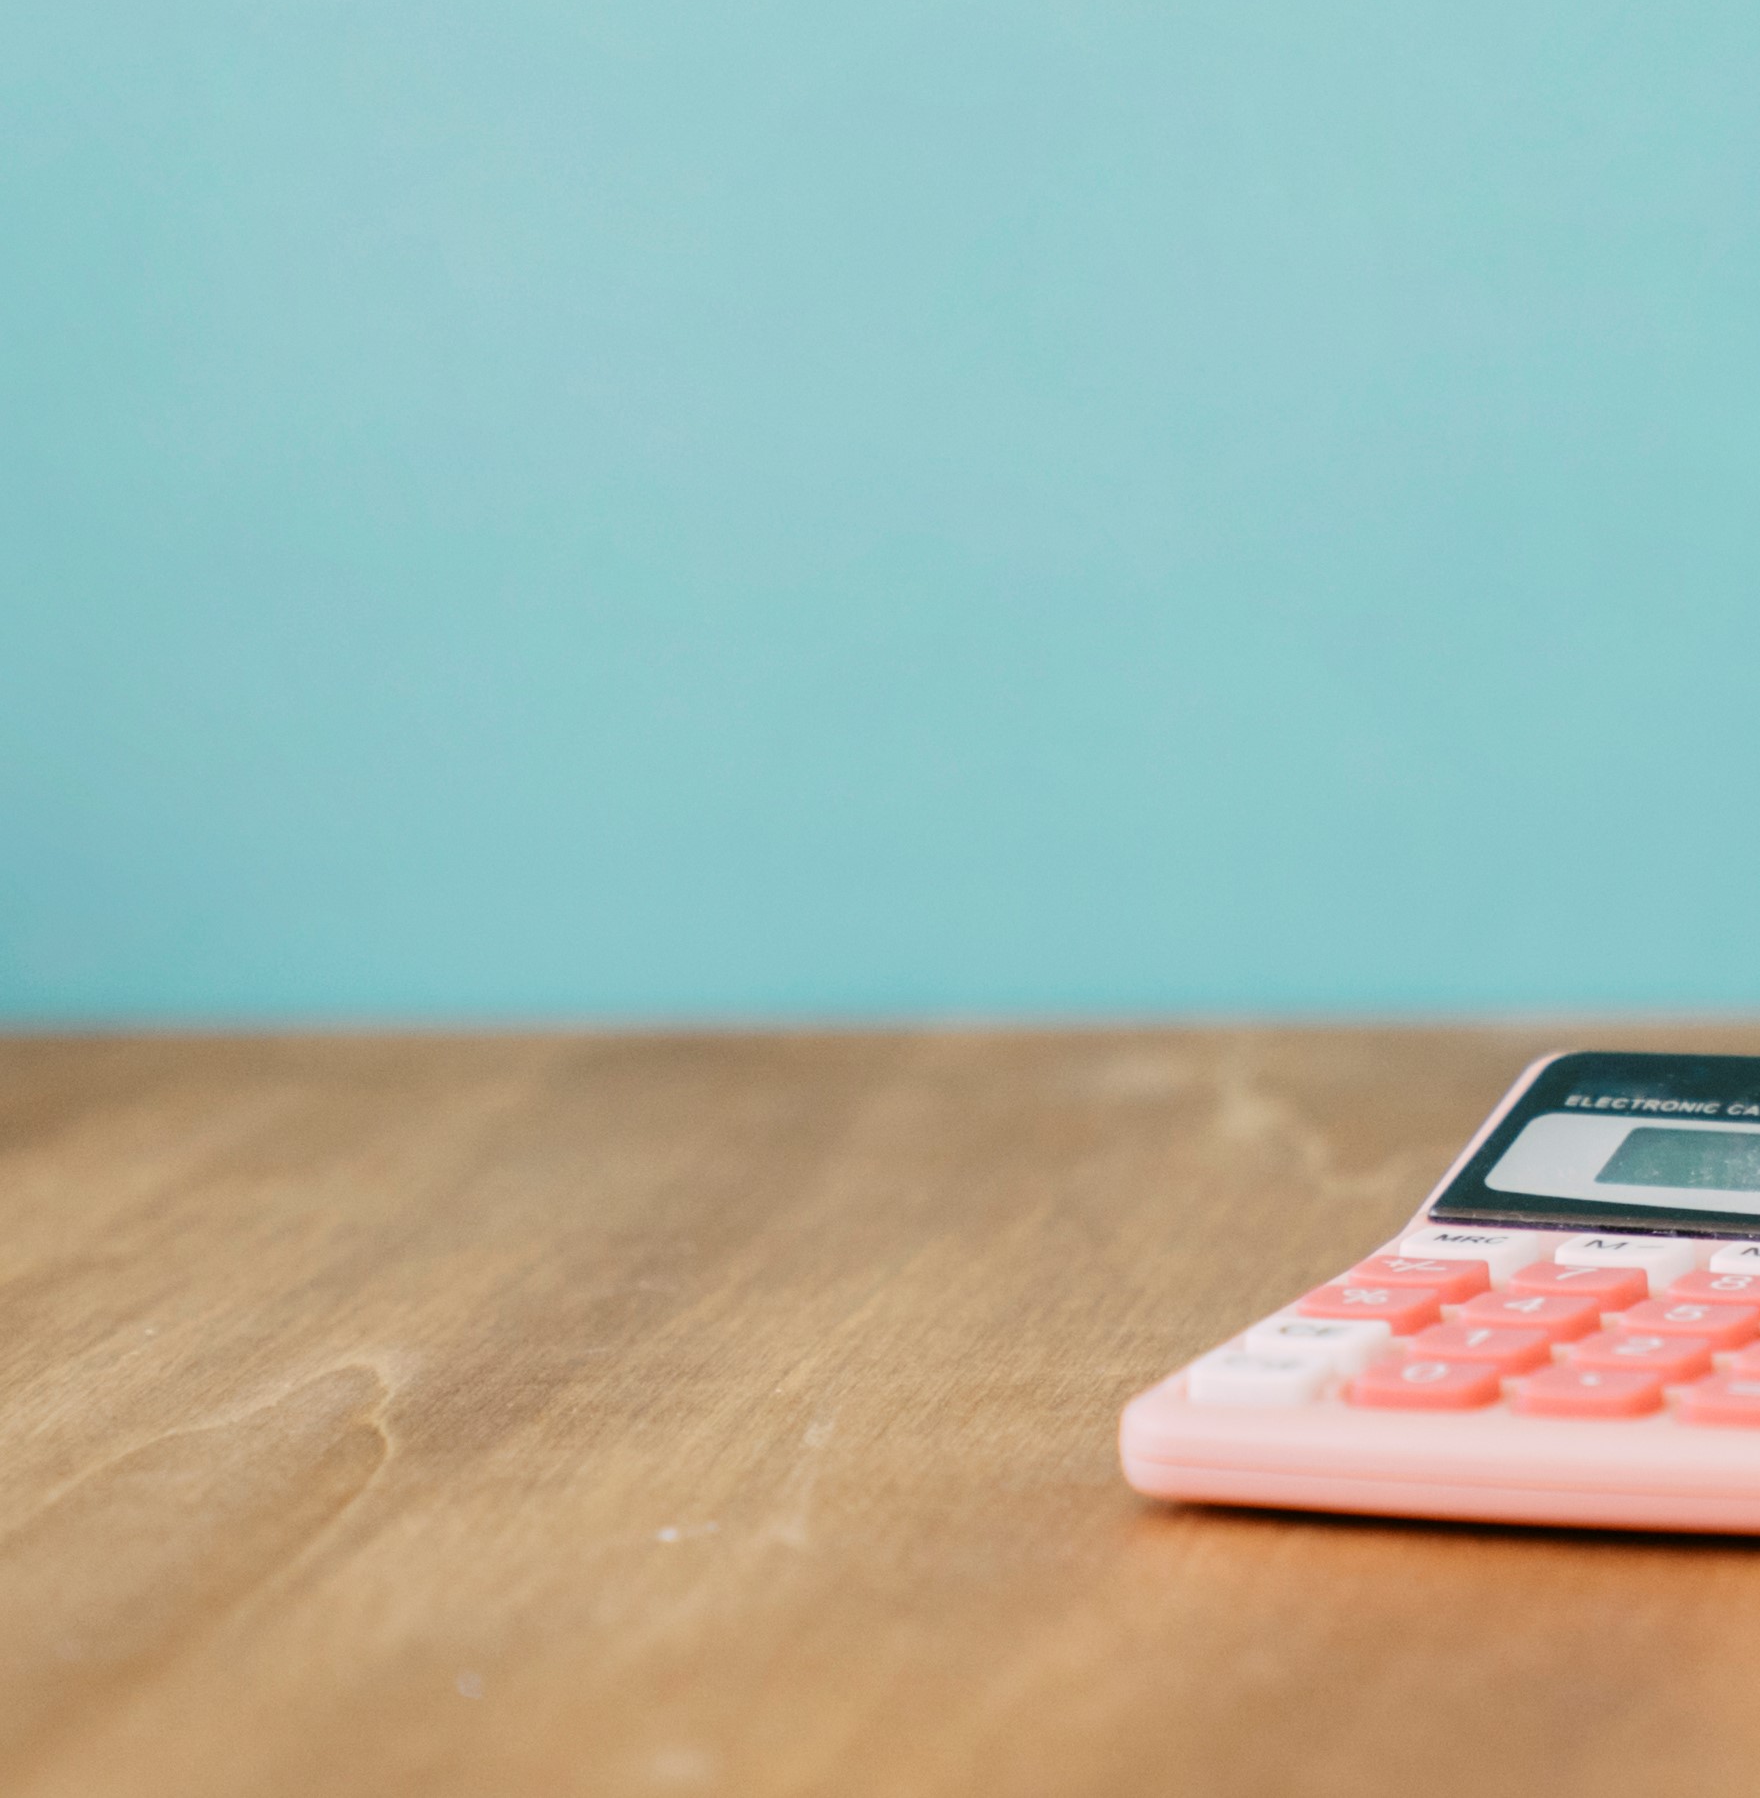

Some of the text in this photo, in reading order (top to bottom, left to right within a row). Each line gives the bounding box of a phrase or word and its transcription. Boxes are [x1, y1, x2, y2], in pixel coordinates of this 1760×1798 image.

[1564, 1095, 1719, 1114] ELECTRONIC
[1434, 1233, 1508, 1245] MRC
[1556, 1266, 1599, 1280] 7
[1710, 1276, 1753, 1291] 8
[1504, 1296, 1546, 1313] 4
[1663, 1305, 1710, 1321] 5
